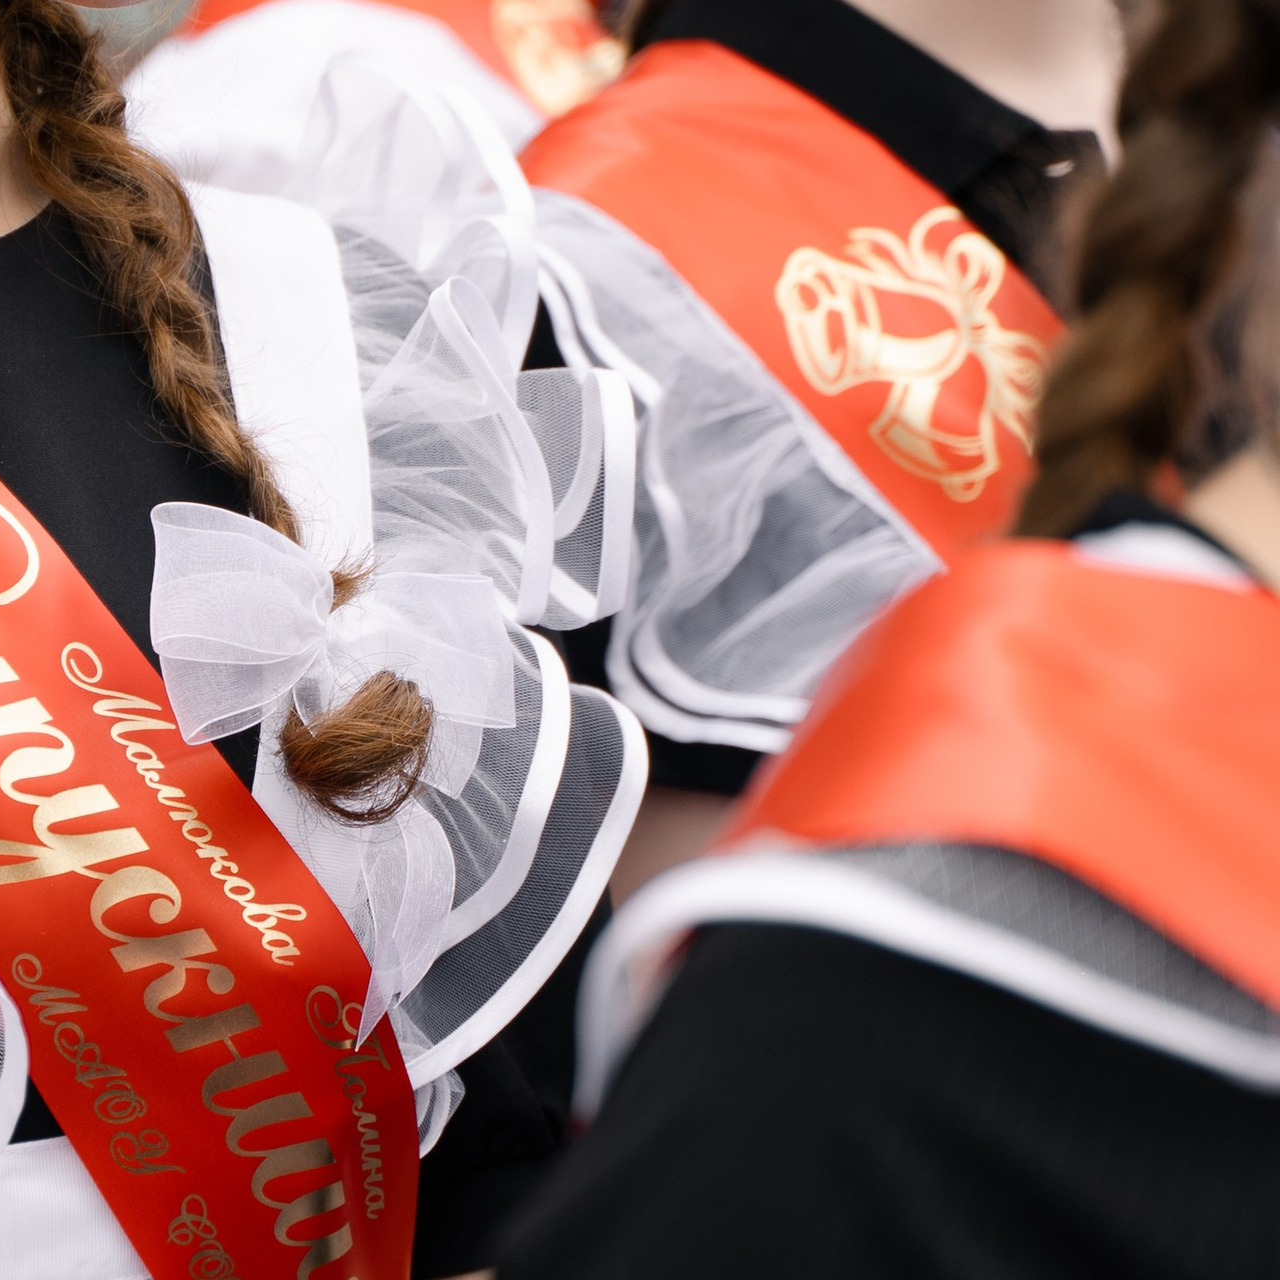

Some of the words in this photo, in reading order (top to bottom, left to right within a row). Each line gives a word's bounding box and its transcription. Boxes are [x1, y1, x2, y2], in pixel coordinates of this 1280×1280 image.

[10, 952, 187, 1176] МАОУ
[61, 641, 308, 967] Малюкова
[305, 984, 392, 1220] Полина
